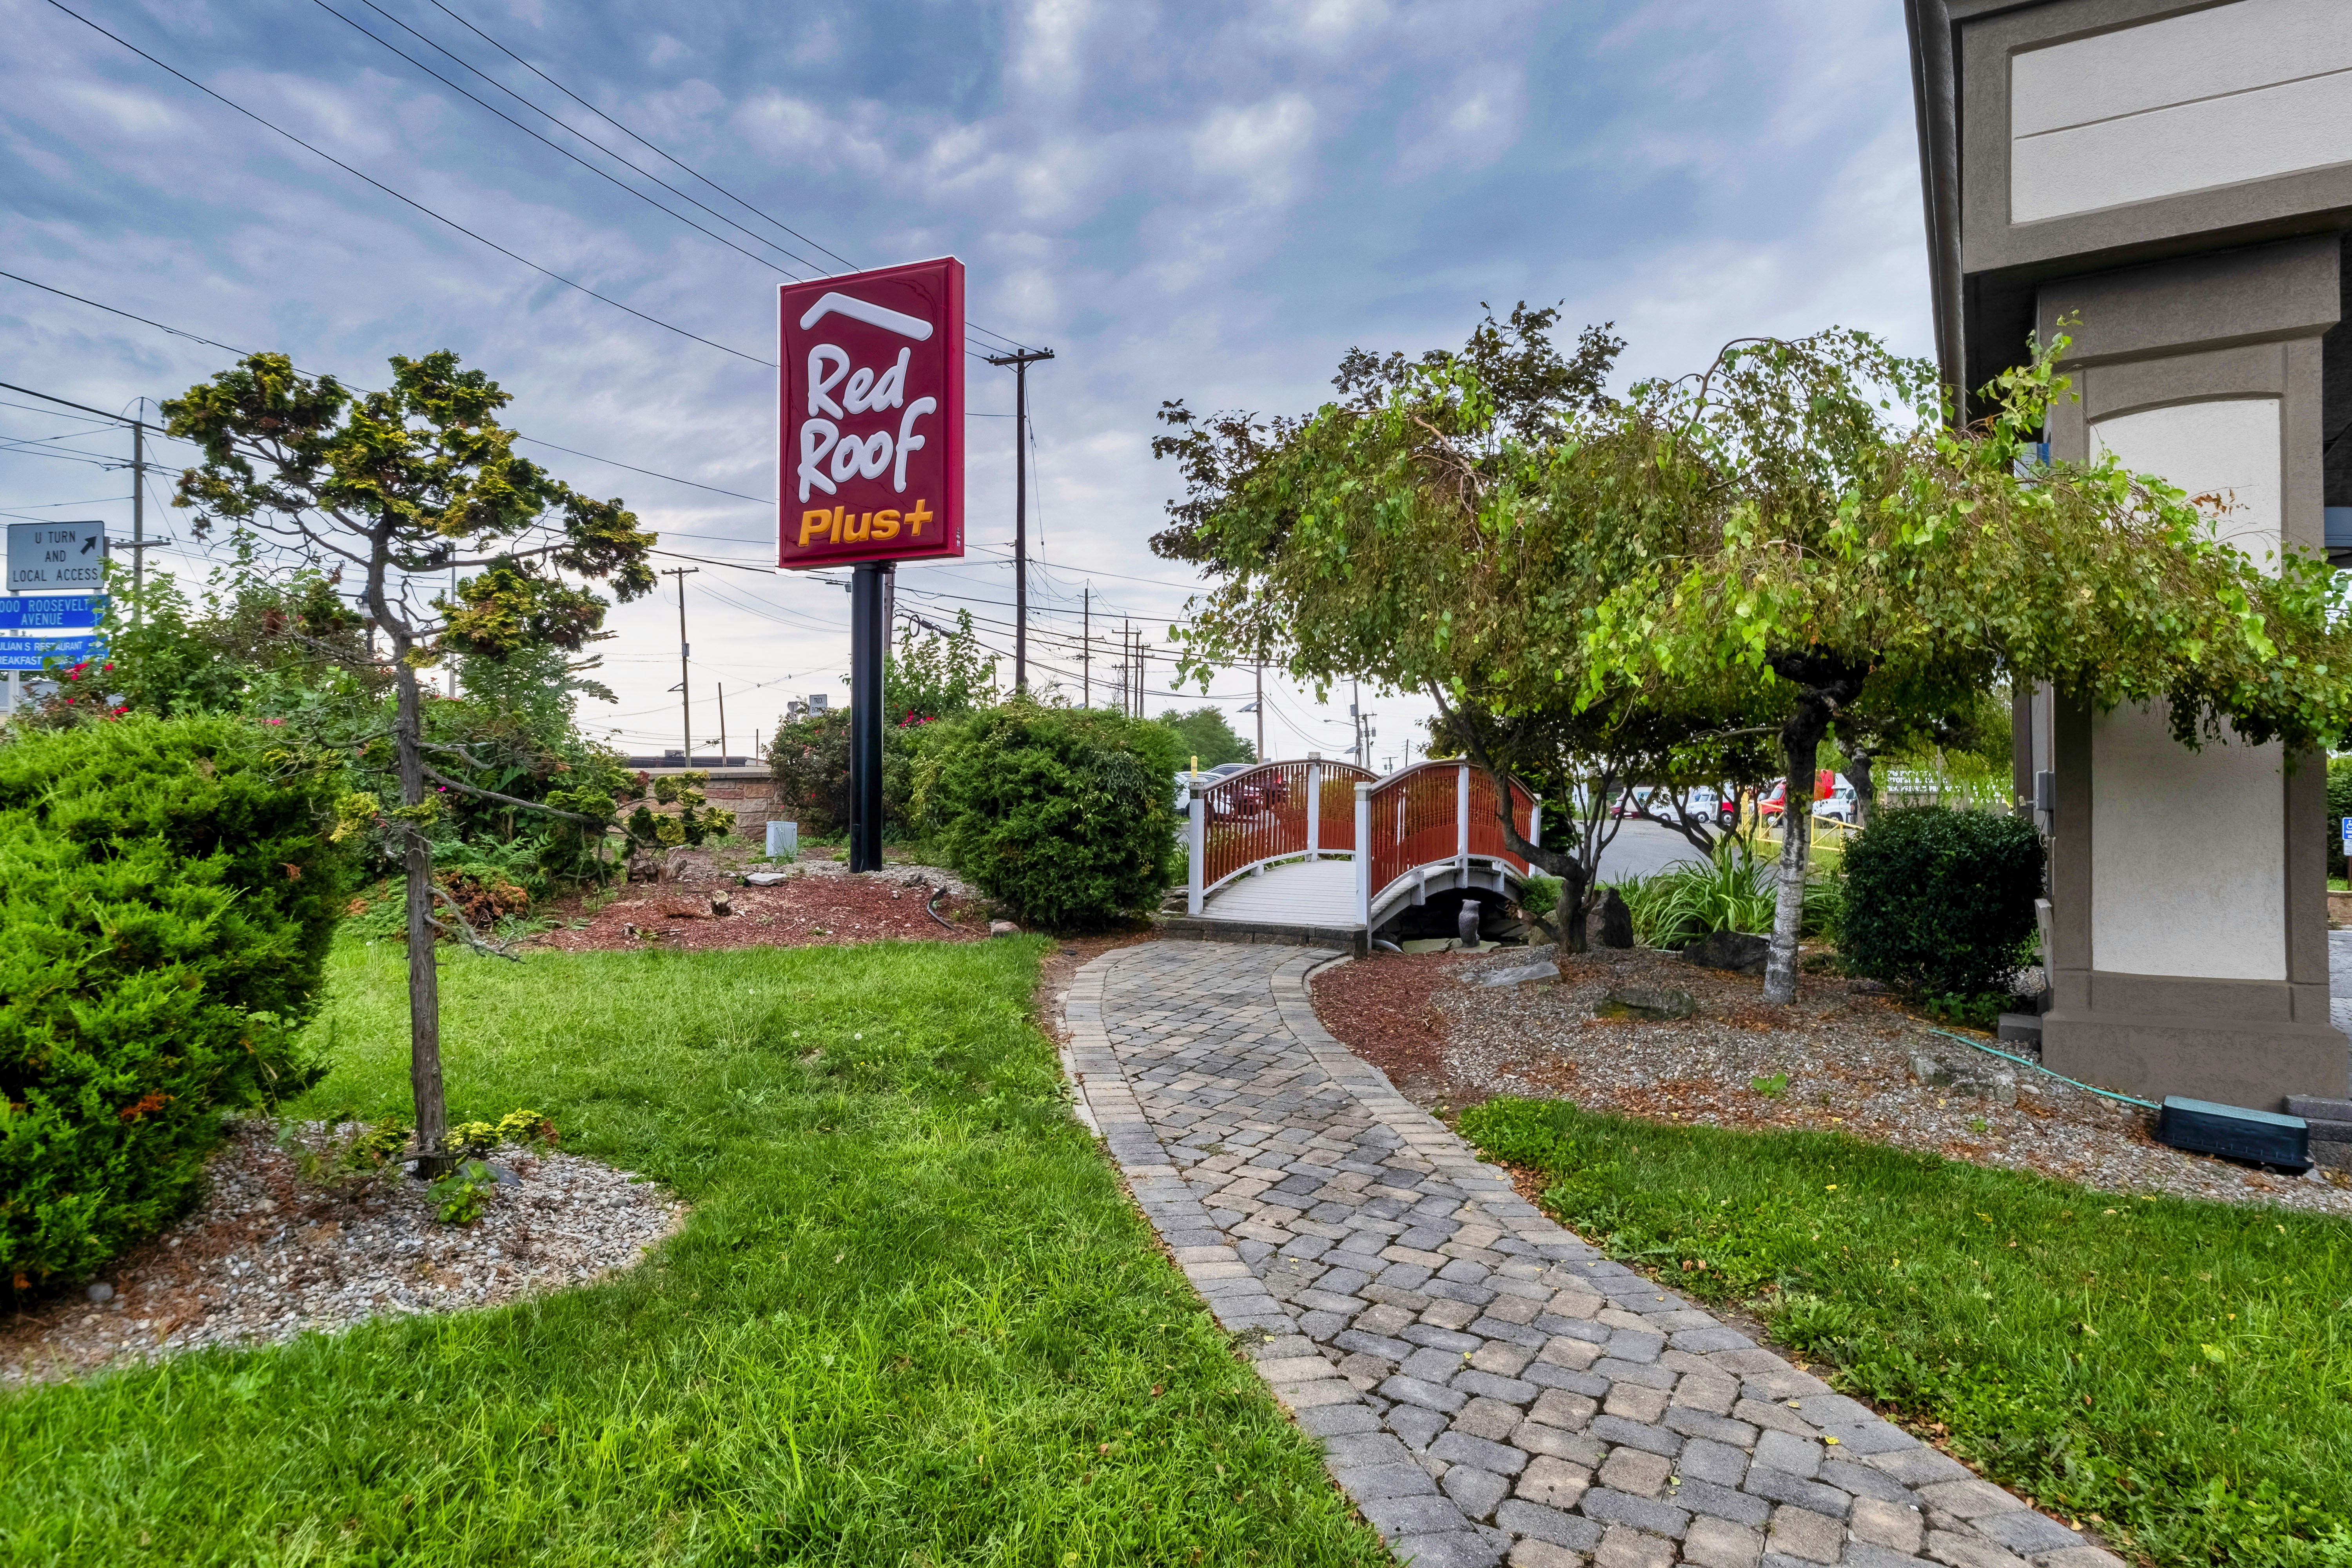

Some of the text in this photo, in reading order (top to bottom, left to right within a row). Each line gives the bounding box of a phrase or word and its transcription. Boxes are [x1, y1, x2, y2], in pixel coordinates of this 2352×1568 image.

[808, 343, 911, 420] Red
[797, 396, 937, 503] Roof
[798, 499, 933, 547] Plus+
[35, 531, 76, 544] U TURN
[45, 550, 66, 563] AND
[13, 568, 98, 582] LOCAL ACCESS
[28, 599, 89, 612] ROOSEVELT
[21, 613, 64, 626] AVENUE
[24, 642, 31, 651] S
